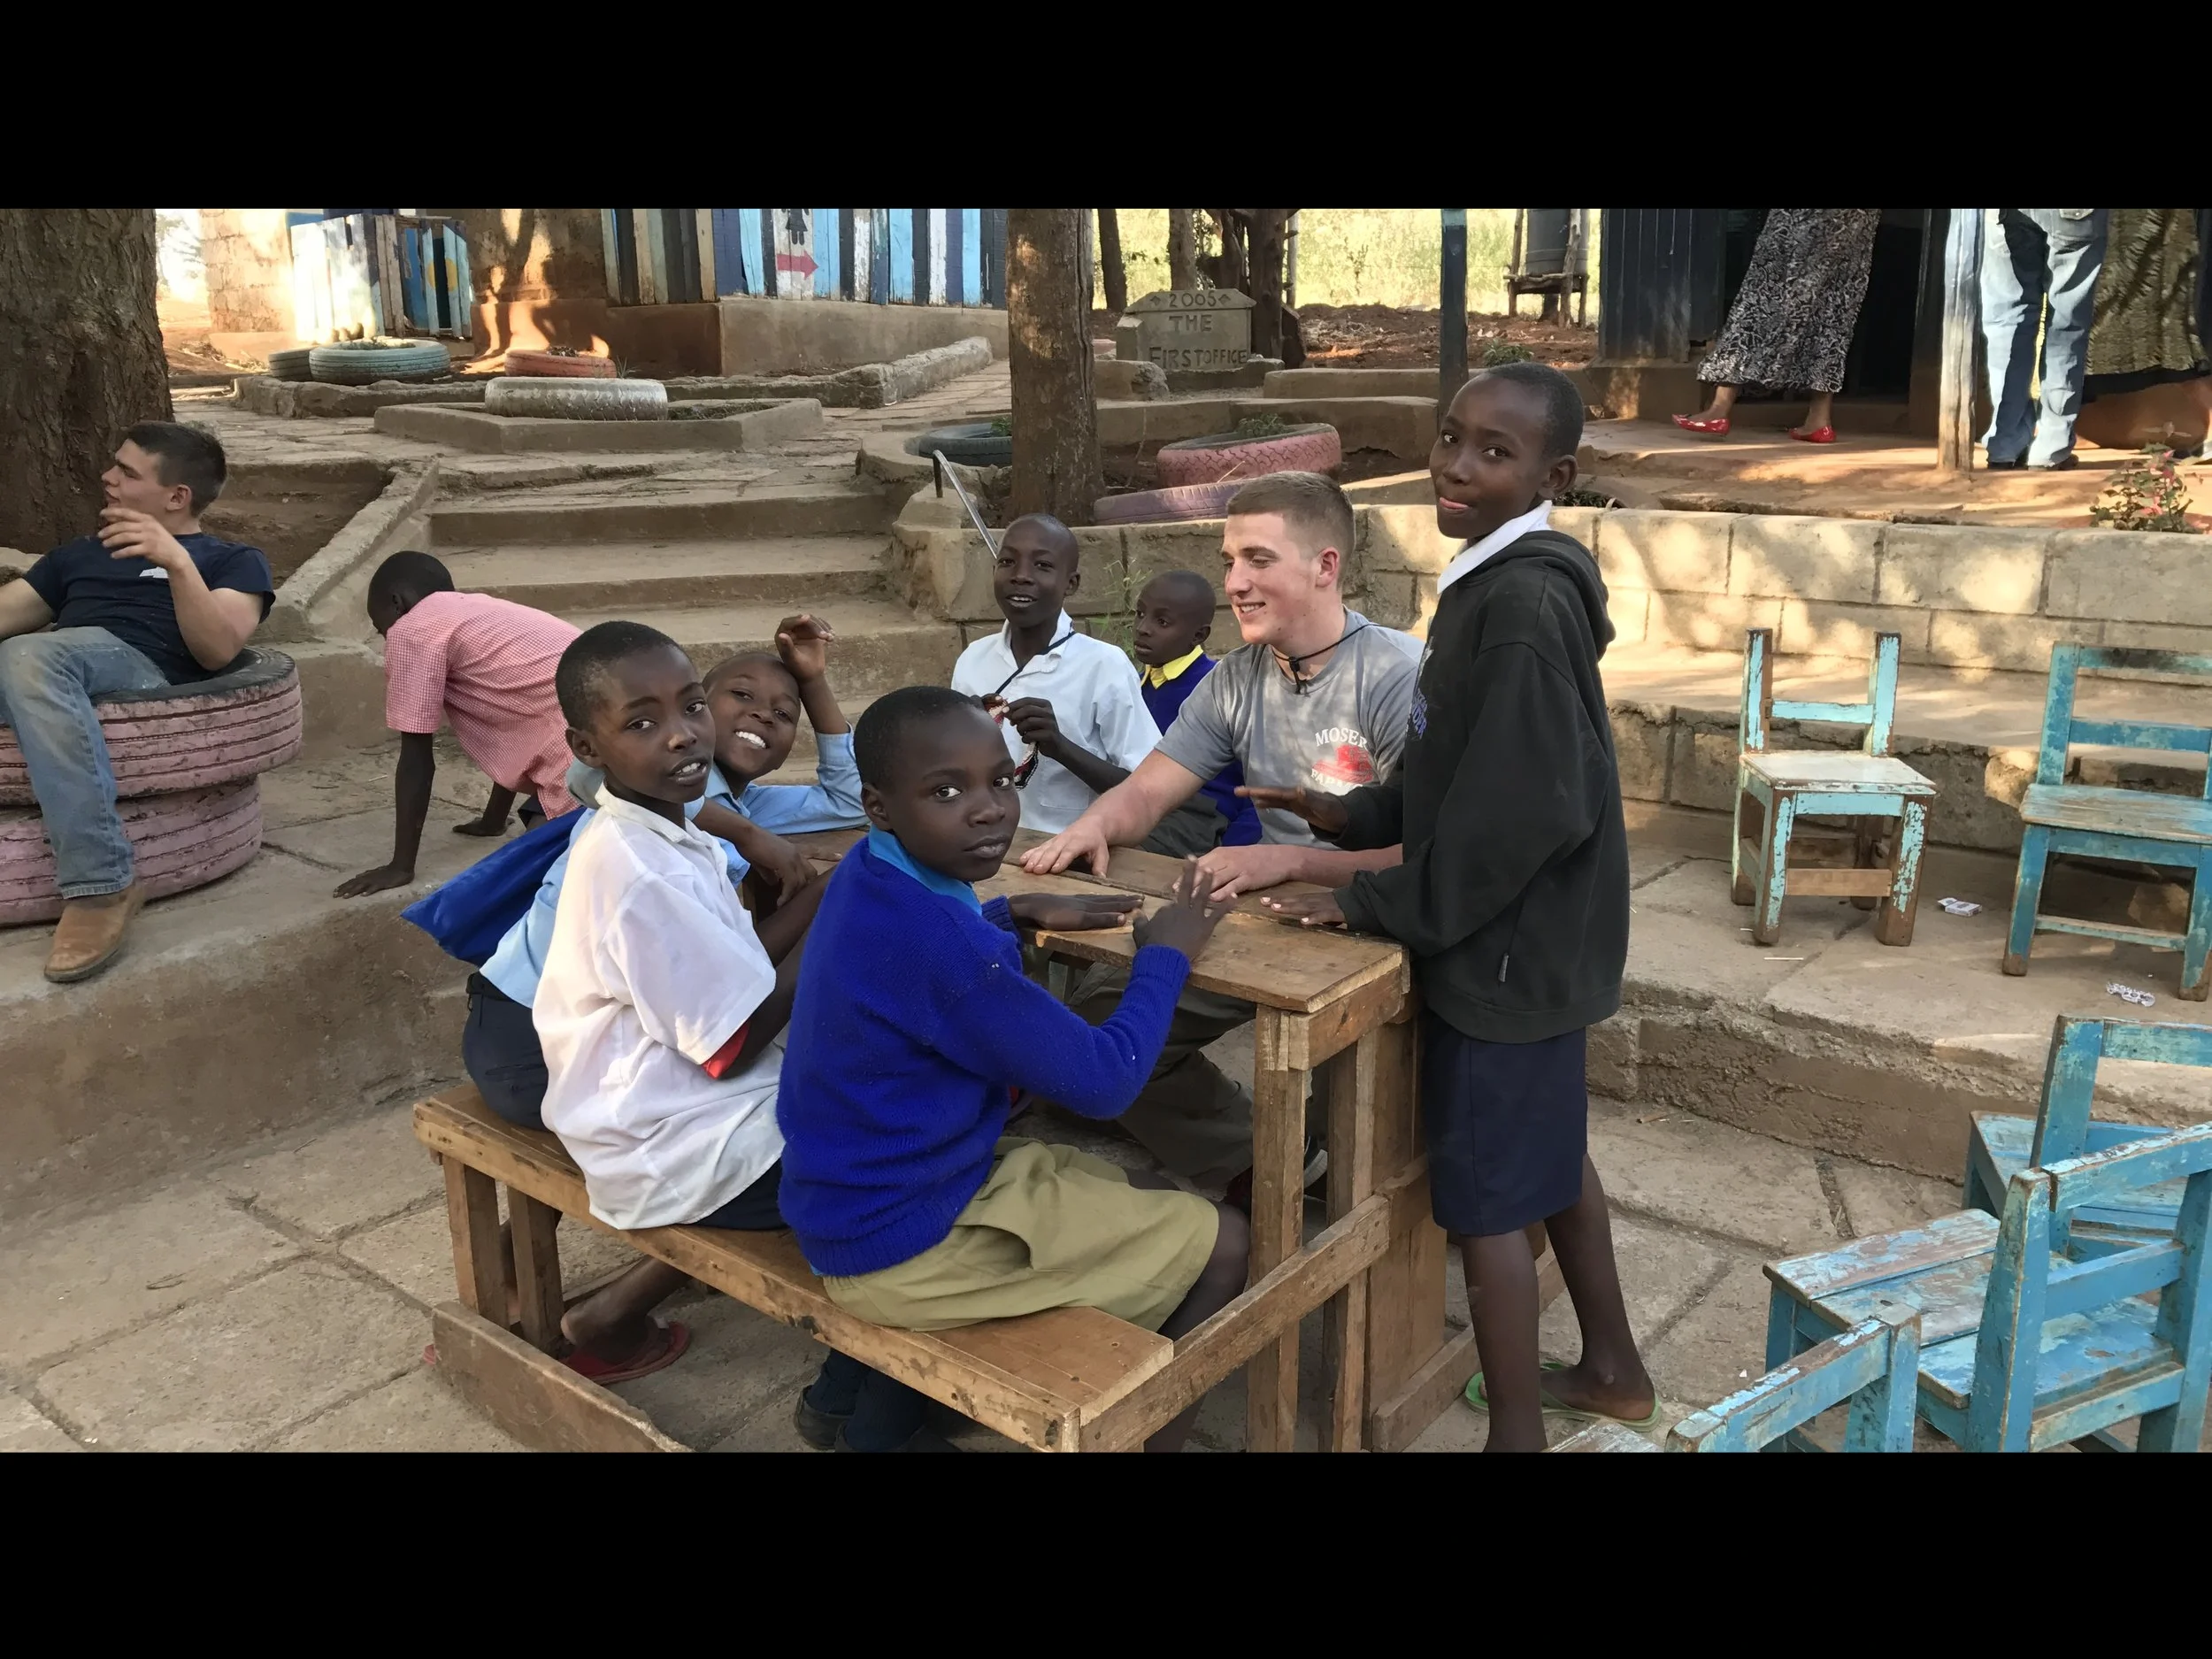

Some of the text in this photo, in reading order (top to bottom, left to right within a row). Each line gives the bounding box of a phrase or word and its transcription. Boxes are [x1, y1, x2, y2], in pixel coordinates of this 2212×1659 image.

[1169, 290, 1217, 308] 2005
[1169, 314, 1213, 333] THE
[1315, 726, 1370, 752] MOSER
